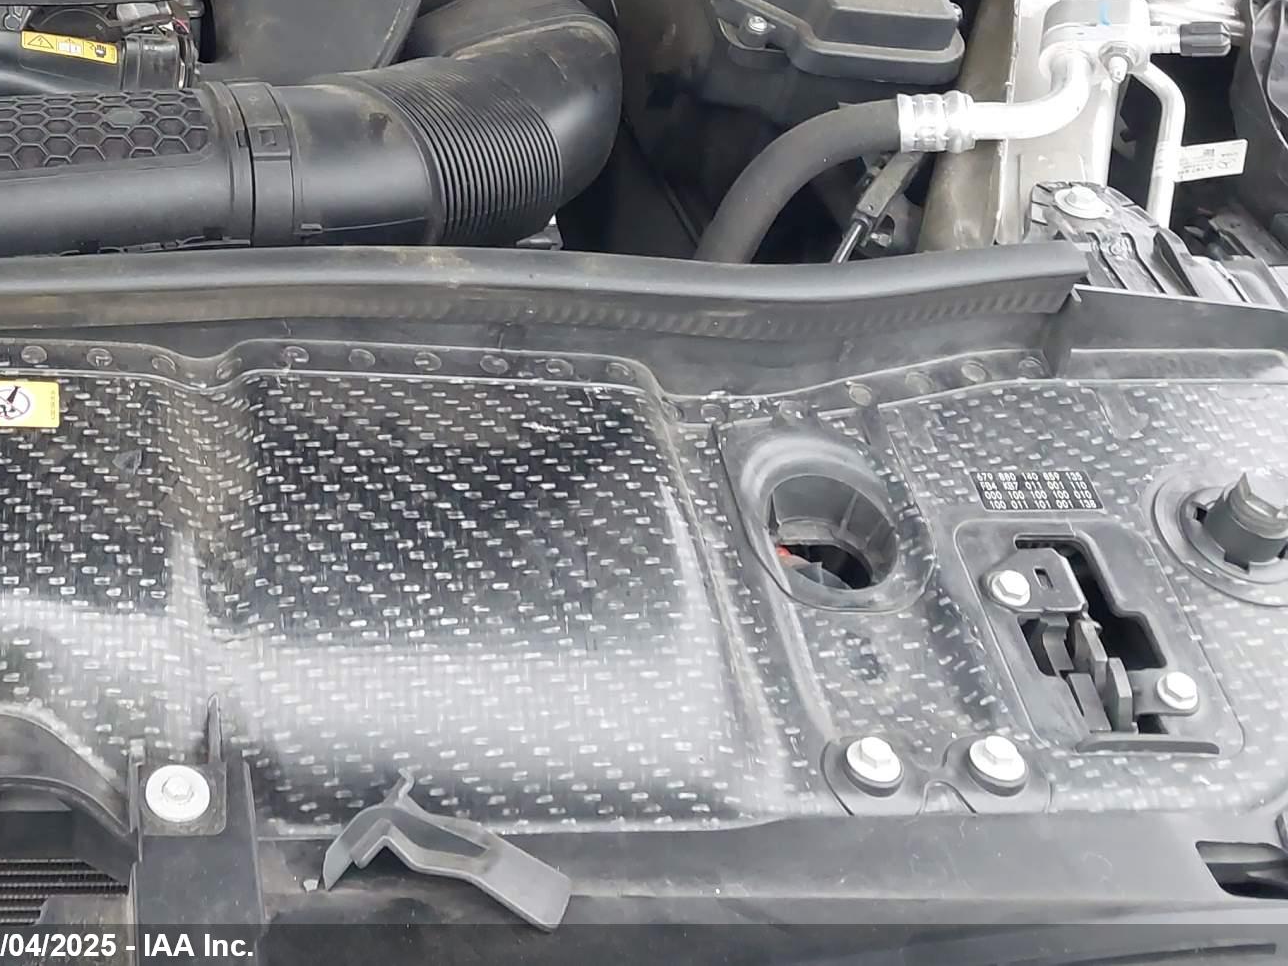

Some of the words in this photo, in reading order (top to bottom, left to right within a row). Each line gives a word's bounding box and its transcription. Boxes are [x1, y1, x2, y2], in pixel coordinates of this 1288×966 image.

[1025, 481, 1043, 491] 011
[1047, 481, 1065, 491] 001
[1070, 481, 1087, 491] 110
[984, 490, 1002, 500] 000
[1008, 490, 1025, 500] 100
[1030, 490, 1047, 500] 100
[1053, 490, 1070, 500] 100
[1074, 490, 1092, 500] 010
[990, 500, 1007, 509] 100
[1011, 500, 1029, 509] 011
[1033, 500, 1051, 509] 101
[1056, 500, 1073, 509] 001
